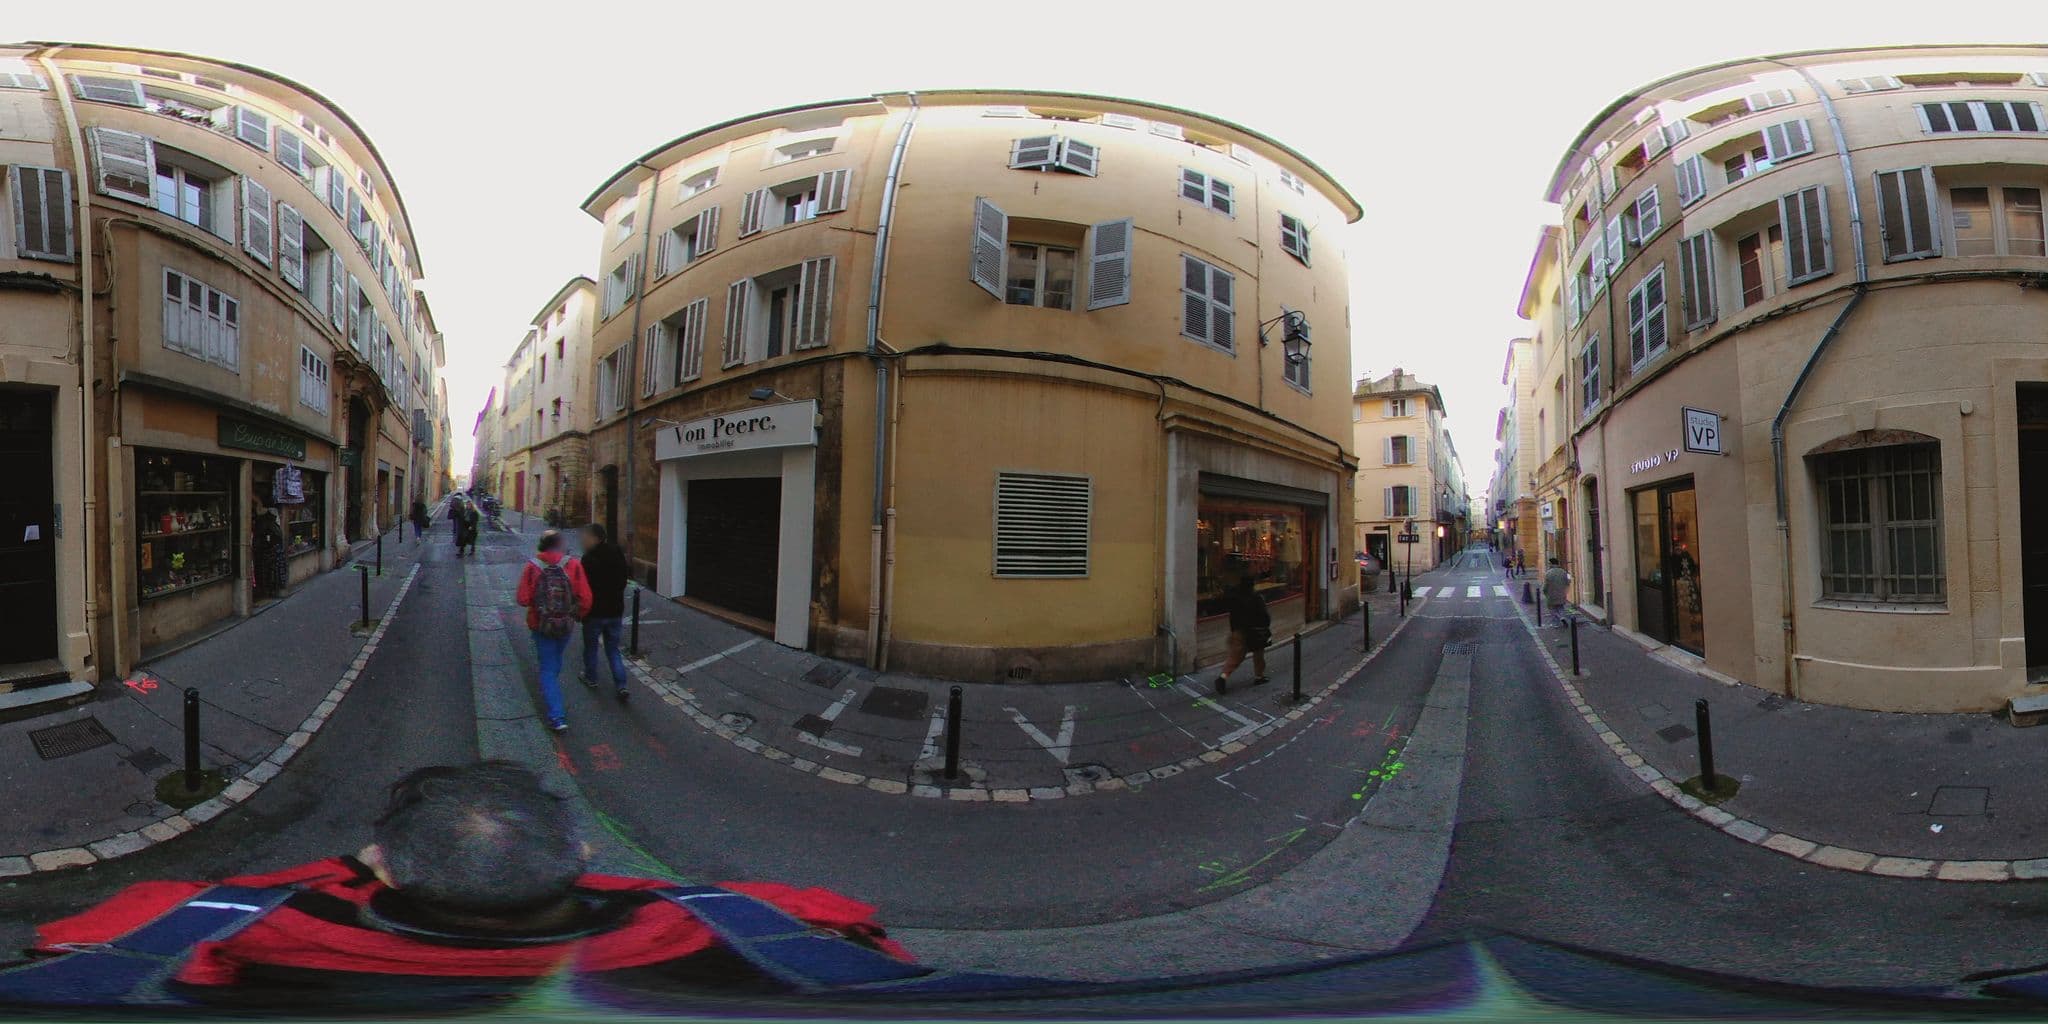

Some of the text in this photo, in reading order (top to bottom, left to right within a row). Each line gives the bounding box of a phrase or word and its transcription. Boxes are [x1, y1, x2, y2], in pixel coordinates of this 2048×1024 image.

[675, 415, 776, 445] Von Peerc.
[1692, 426, 1715, 446] VP
[1630, 448, 1679, 474] STUDIO VP
